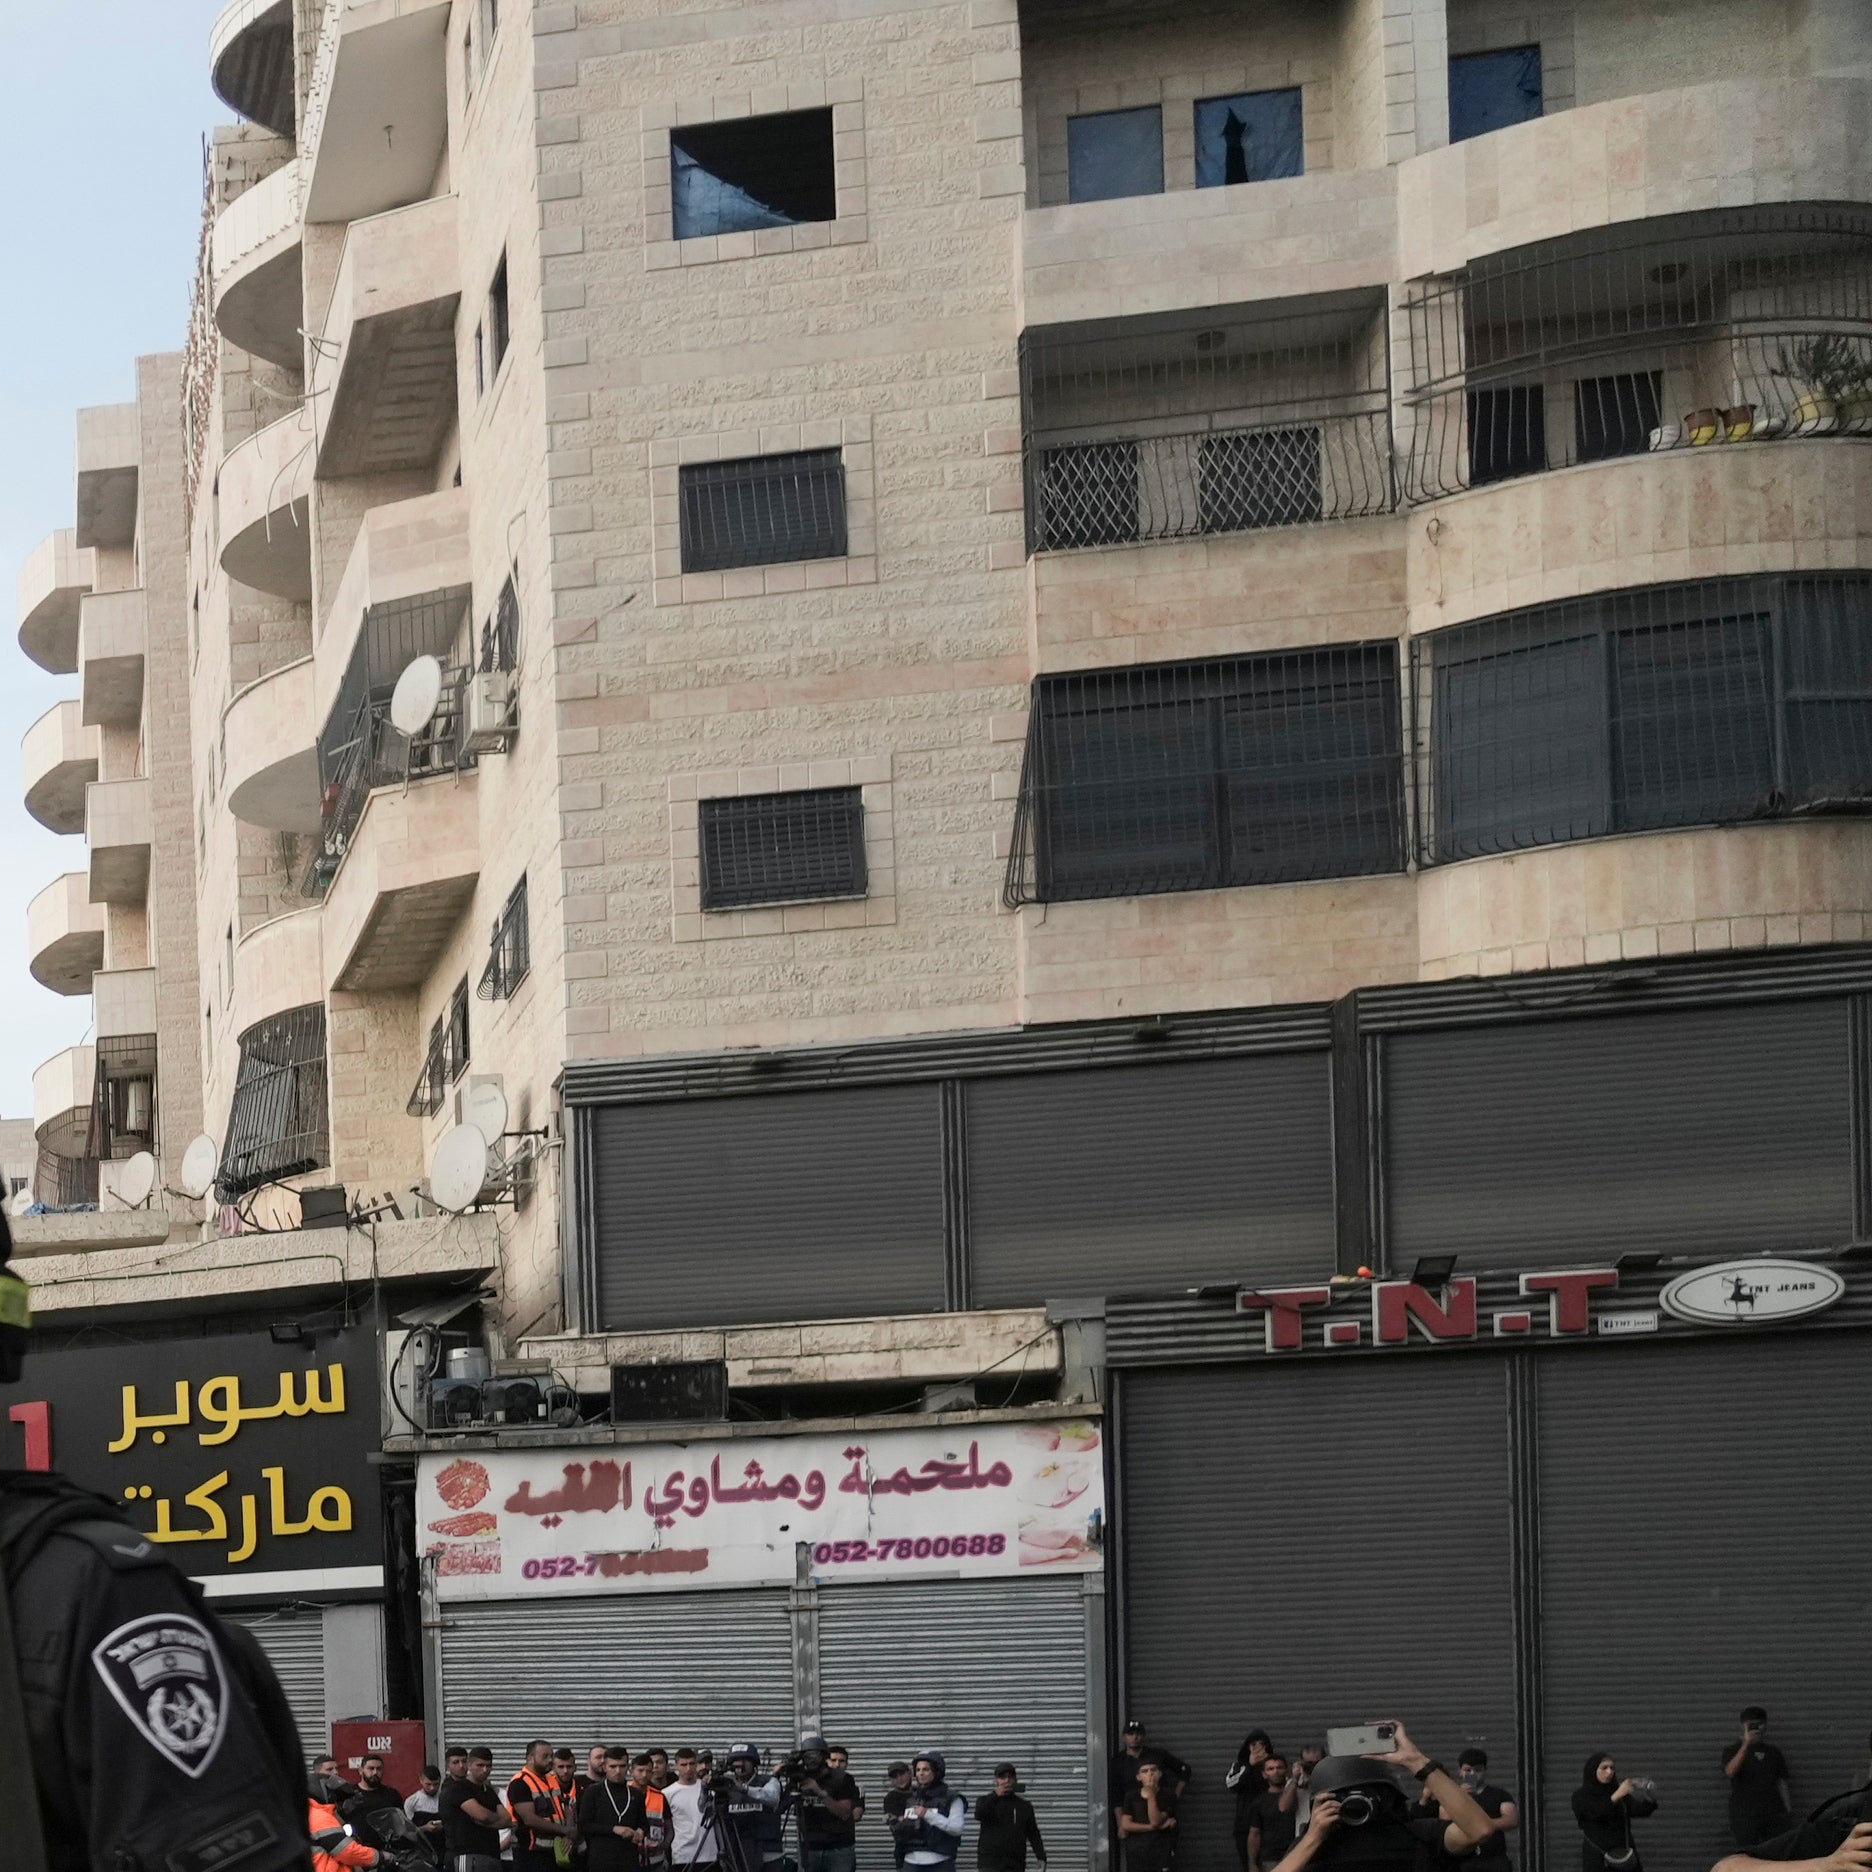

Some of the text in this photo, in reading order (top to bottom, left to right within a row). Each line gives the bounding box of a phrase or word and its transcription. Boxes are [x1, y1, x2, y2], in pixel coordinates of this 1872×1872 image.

[1777, 1282, 1816, 1292] JEANS
[108, 1363, 346, 1453] سوبر
[644, 1454, 826, 1527] ومشاوي
[839, 1441, 1013, 1496] ملحمة
[124, 1466, 352, 1563] ماركت
[813, 1534, 1007, 1565] 052-7800688
[367, 1736, 392, 1751] אש
